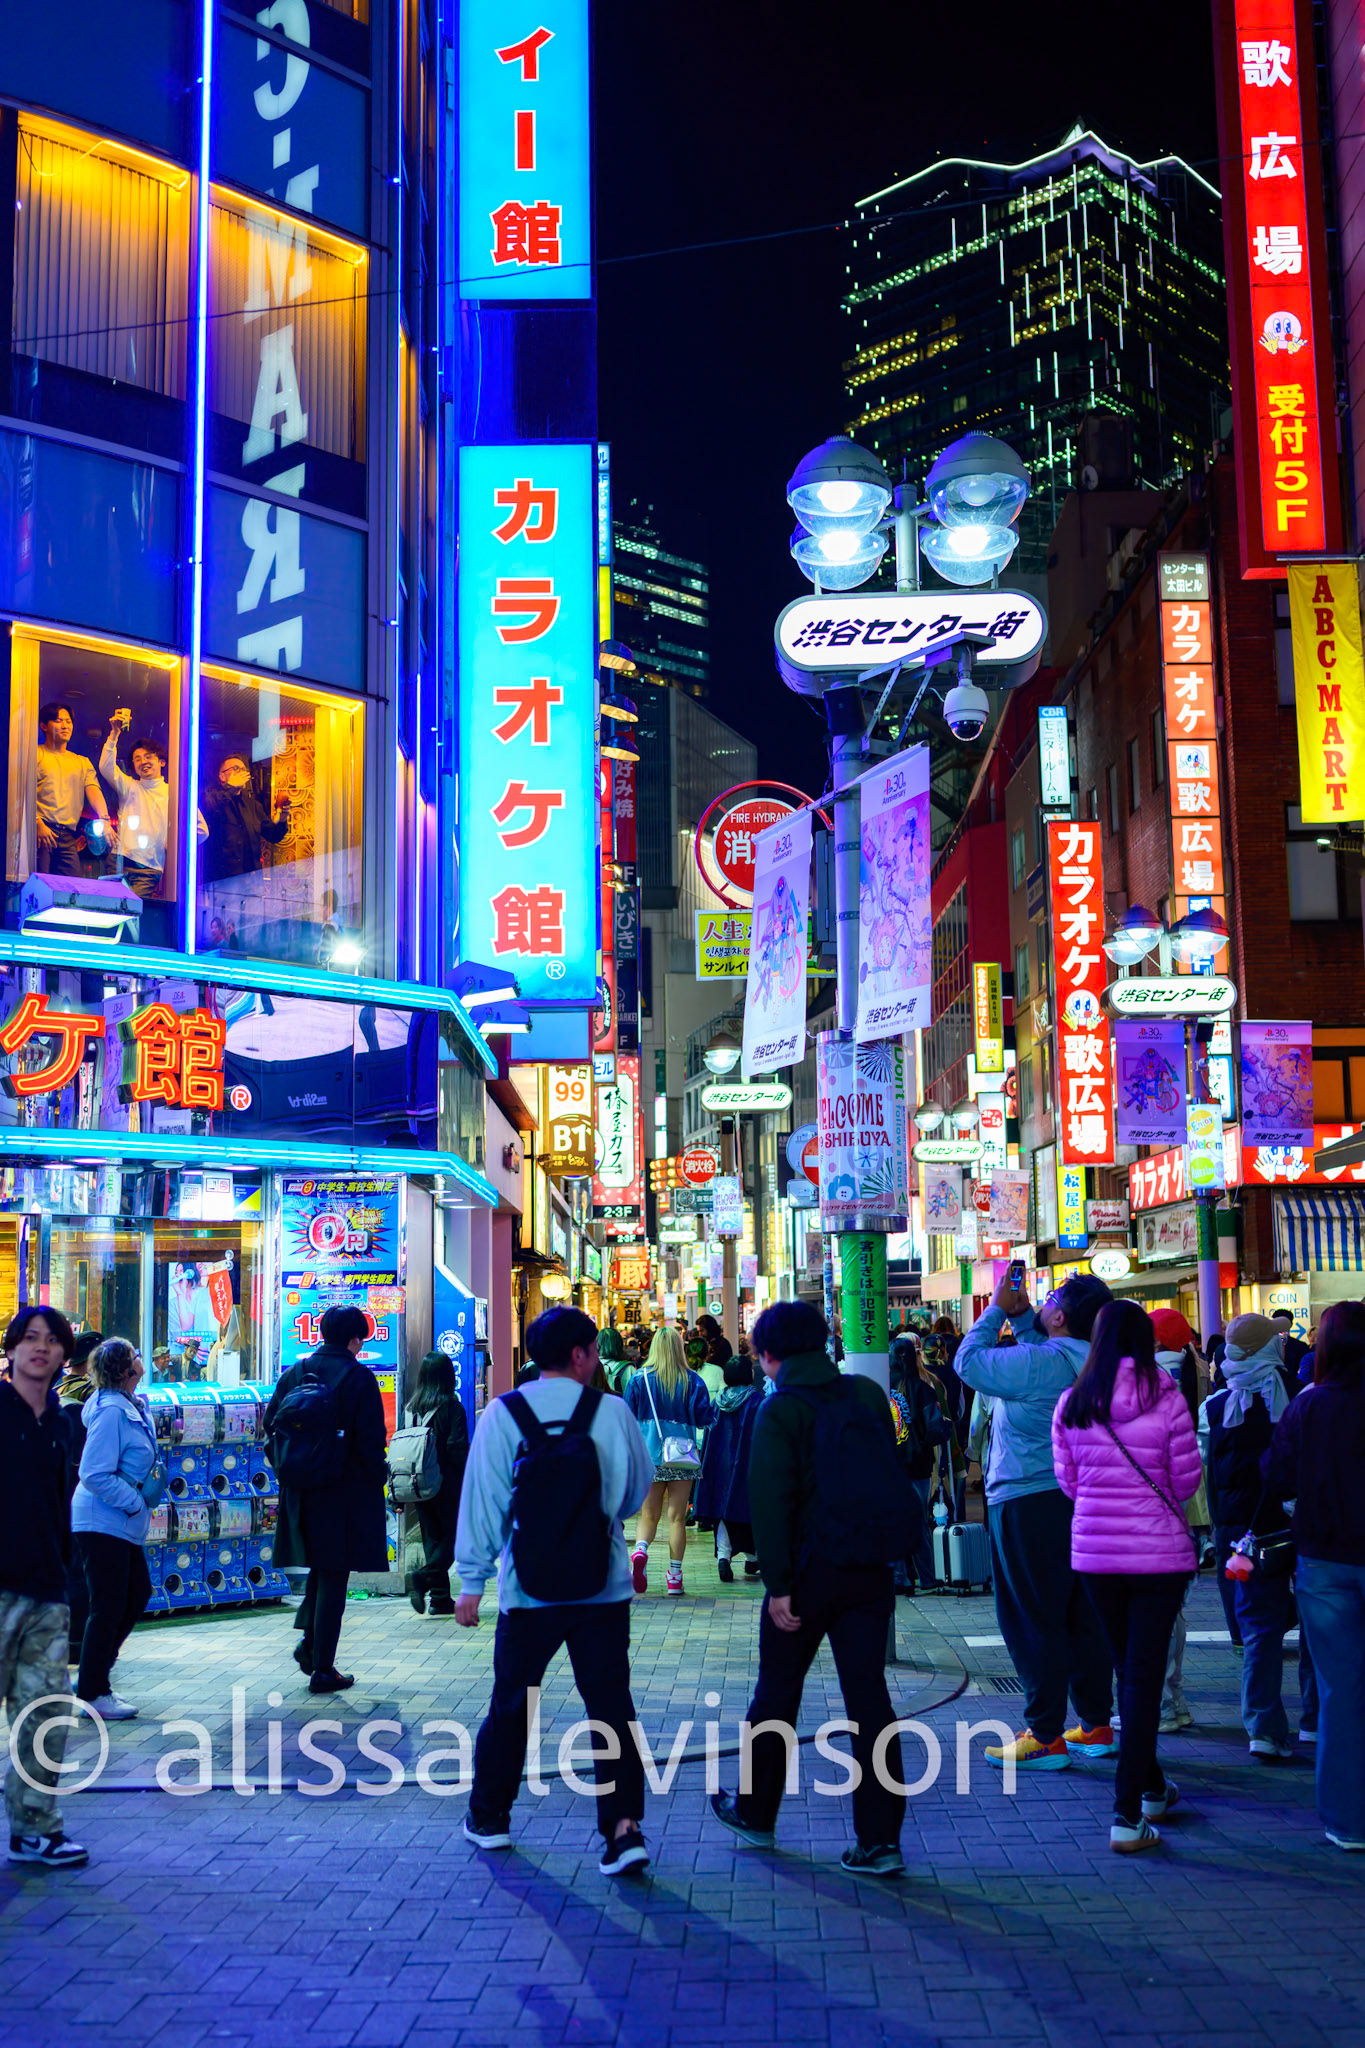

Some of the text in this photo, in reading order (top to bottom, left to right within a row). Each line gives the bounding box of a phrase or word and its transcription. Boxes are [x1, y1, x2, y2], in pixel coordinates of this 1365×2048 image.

[1240, 40, 1303, 276] 歌広場
[1267, 383, 1309, 532] 受付5F
[791, 610, 1030, 648] 渋谷センター街
[1171, 604, 1206, 733] カラオケ
[491, 477, 567, 958] カラオケ館
[731, 813, 750, 823] FIRE
[1177, 782, 1215, 892] 歌広場
[1057, 824, 1100, 987] カラオケ
[1118, 987, 1229, 1003] 渋谷センター街
[865, 997, 918, 1025] 渋谷センター街
[555, 1081, 585, 1102] 99
[707, 1090, 787, 1104] 渋谷センター街
[1063, 1034, 1108, 1155] 歌広場
[821, 1093, 885, 1131] ELCOME
[553, 1124, 587, 1151] B1
[1128, 1130, 1177, 1138] 渋谷センター街
[1253, 1132, 1304, 1141] 渋谷センター街
[685, 1159, 715, 1174] 消火栓
[1064, 1173, 1080, 1207] 松屋
[619, 1261, 648, 1287] 豚
[860, 1240, 876, 1346] 客引きは犯罪です
[1269, 1293, 1297, 1304] COIN
